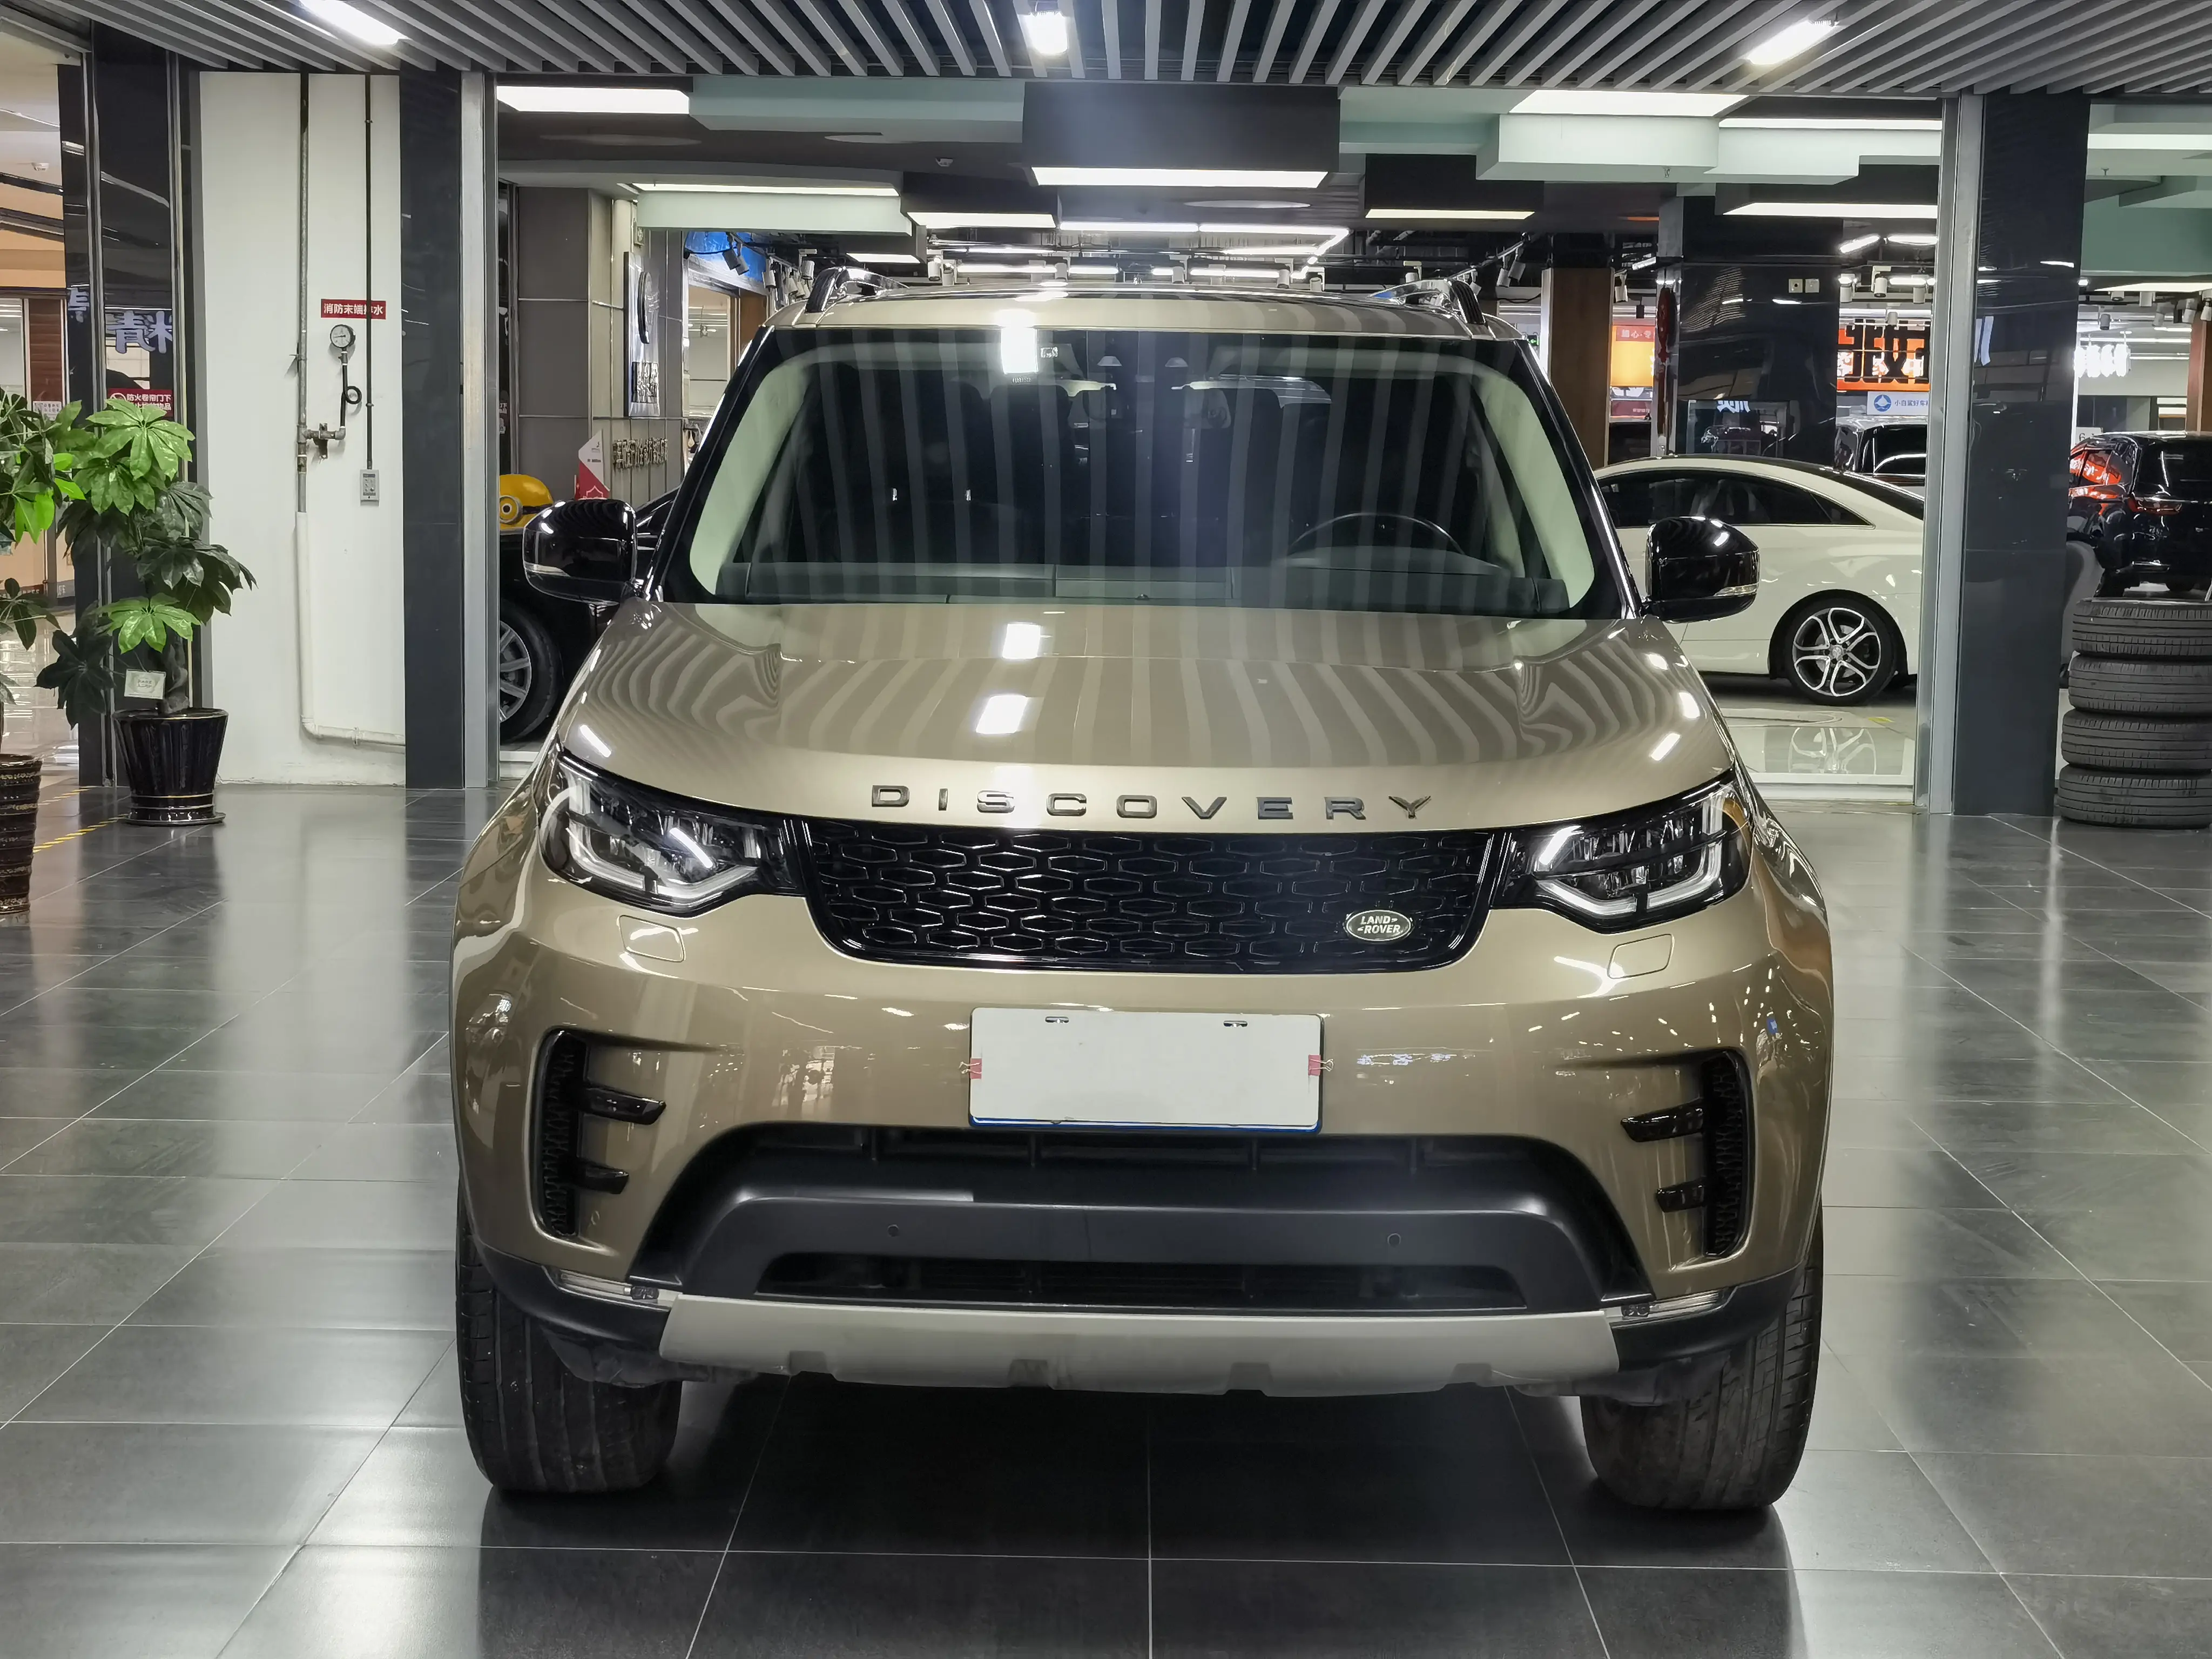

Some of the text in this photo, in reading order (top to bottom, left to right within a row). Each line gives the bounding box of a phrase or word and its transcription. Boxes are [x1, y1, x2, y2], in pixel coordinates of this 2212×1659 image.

[872, 785, 1431, 820] DISCOVERY
[1360, 916, 1390, 925] LAND
[1364, 925, 1400, 934] ROVER
